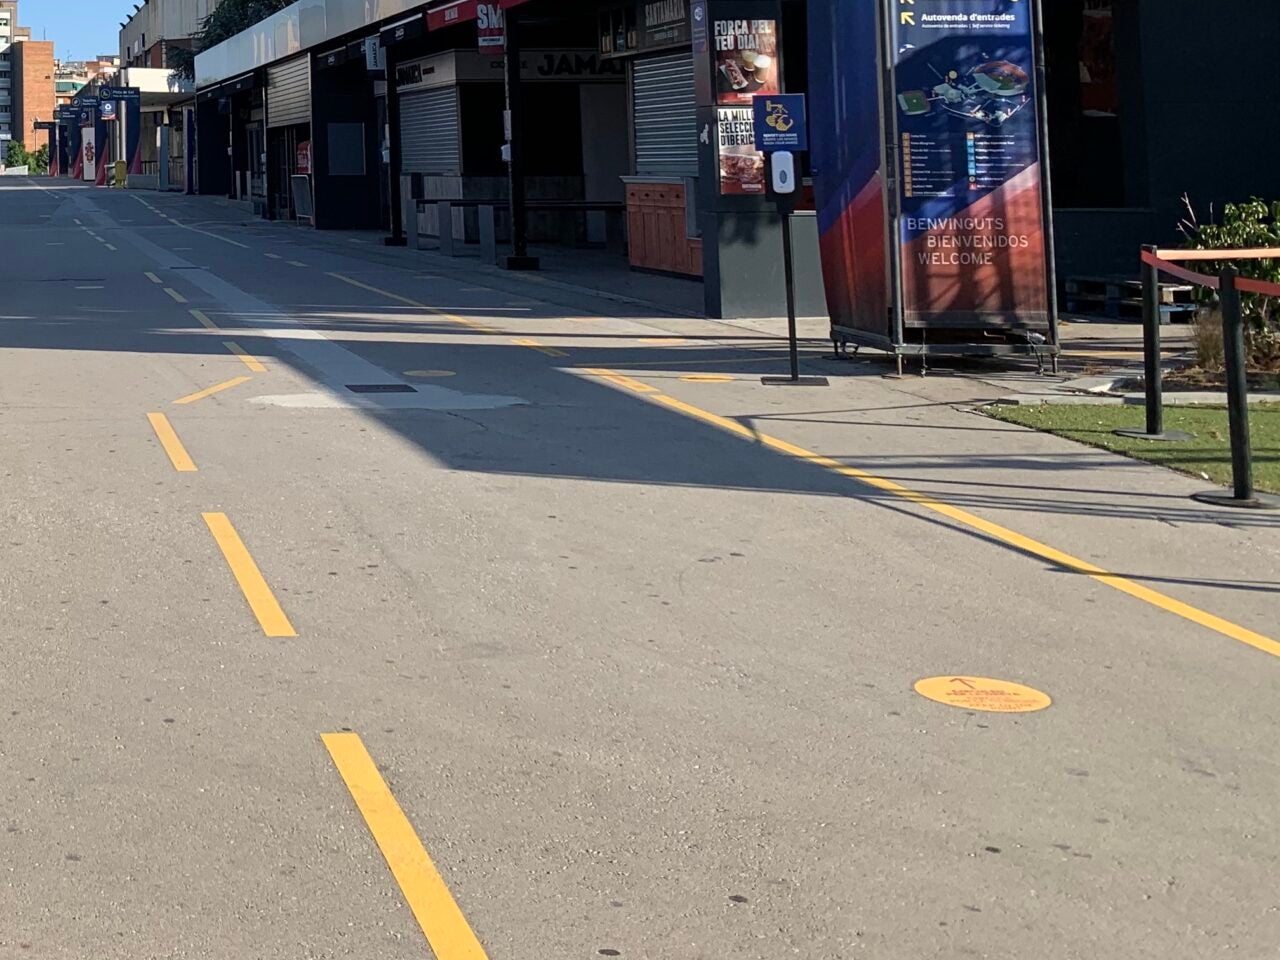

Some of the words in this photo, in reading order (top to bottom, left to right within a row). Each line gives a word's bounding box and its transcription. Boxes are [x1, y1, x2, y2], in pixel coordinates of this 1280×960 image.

[476, 2, 504, 30] SM
[920, 13, 968, 22] Autovenda
[969, 13, 1016, 22] d'entrades
[714, 35, 734, 51] TEU
[718, 110, 729, 122] LA
[907, 217, 1004, 230] BENVINGUTS
[927, 235, 1029, 248] BIENVENIDOS
[918, 252, 993, 265] WELCOME
